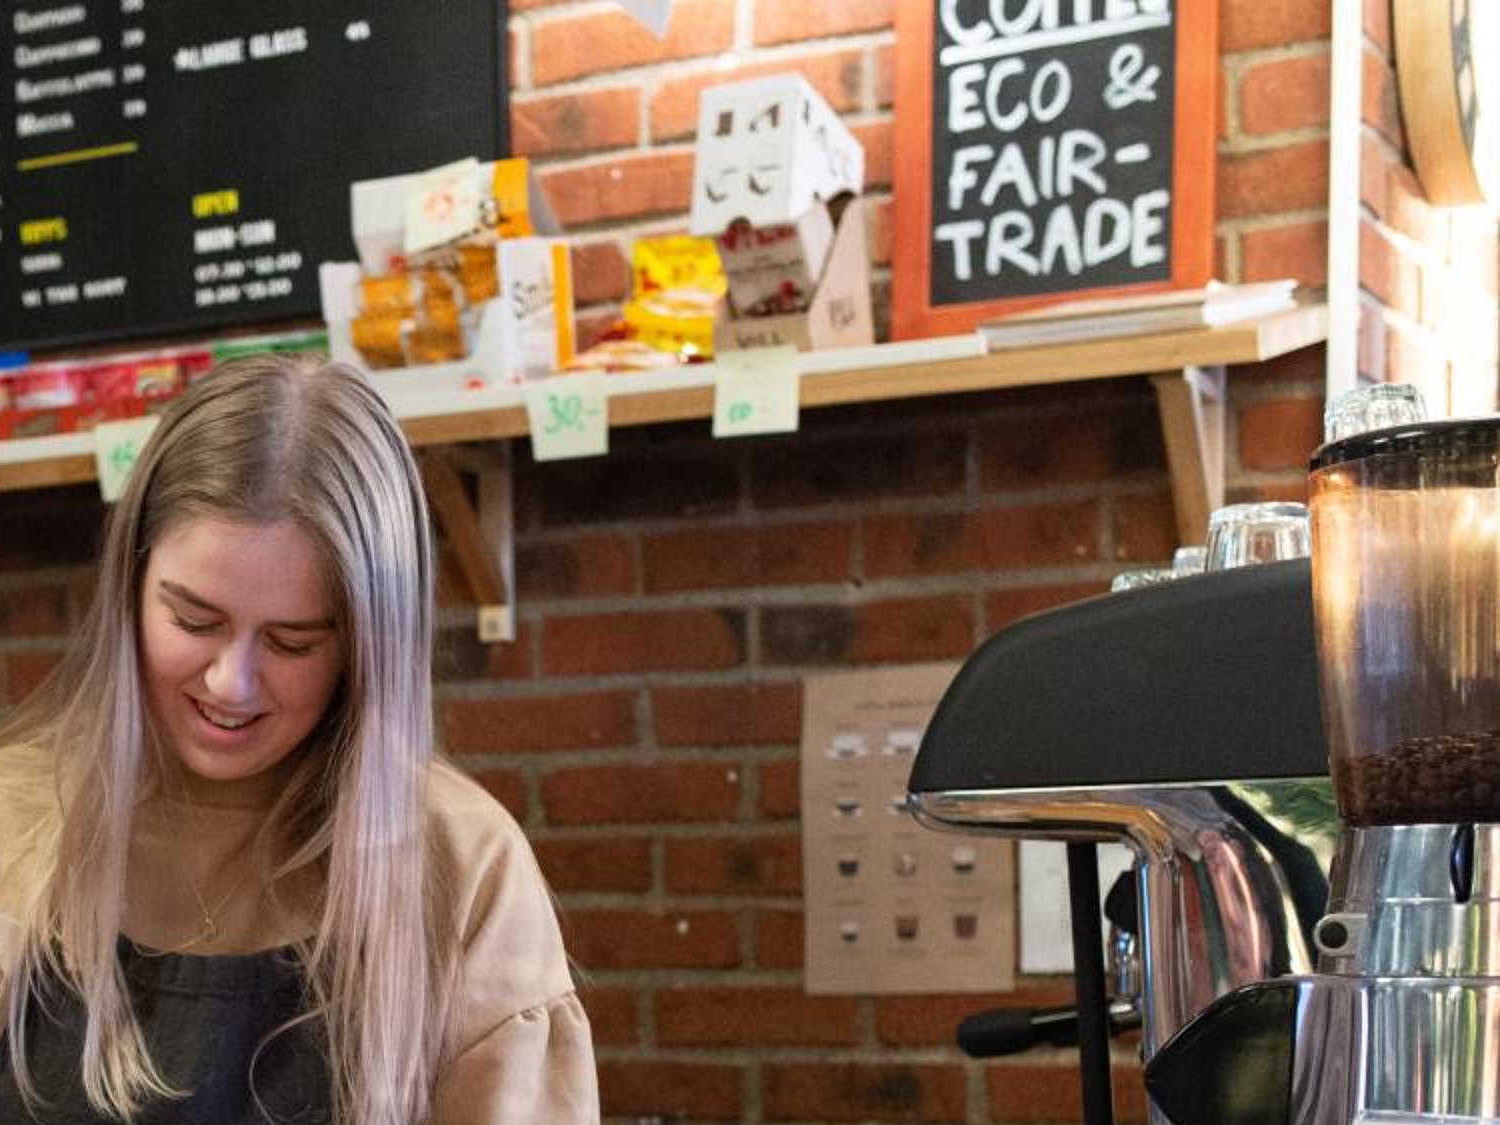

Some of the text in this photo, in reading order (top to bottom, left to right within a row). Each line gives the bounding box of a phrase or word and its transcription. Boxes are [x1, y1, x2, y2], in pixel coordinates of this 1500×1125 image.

[948, 43, 1162, 133] ECO &
[948, 129, 1150, 211] FAIR-
[933, 189, 1171, 281] TRADE
